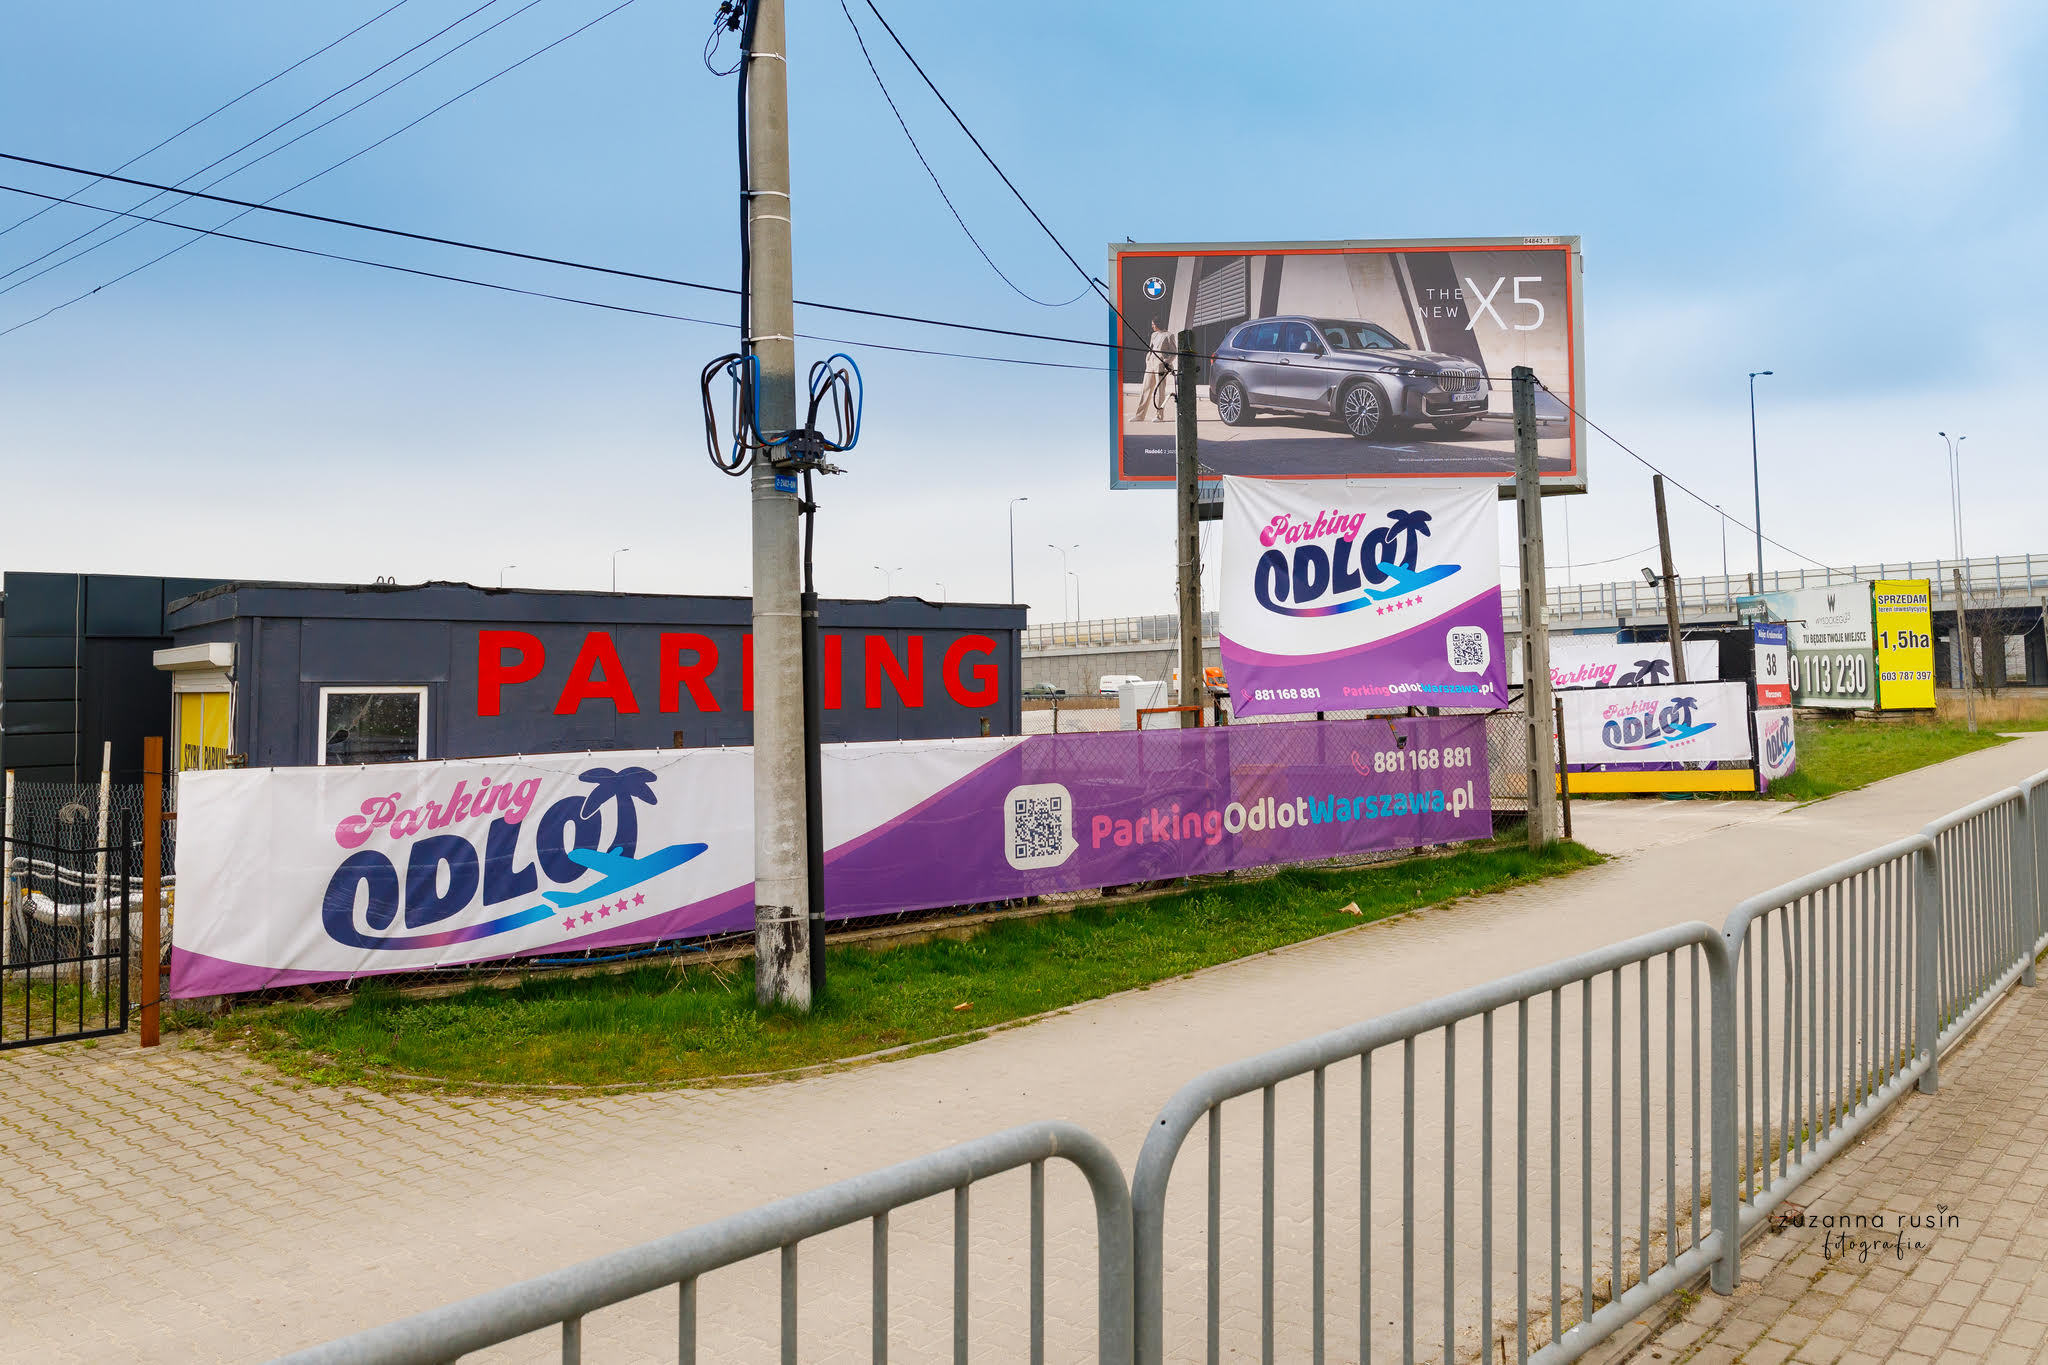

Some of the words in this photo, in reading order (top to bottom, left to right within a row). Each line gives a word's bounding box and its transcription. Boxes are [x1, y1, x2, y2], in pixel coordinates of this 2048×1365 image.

[1425, 288, 1463, 300] THE
[1464, 276, 1545, 331] X5
[1418, 306, 1459, 318] NEW
[1259, 509, 1366, 547] Parking
[1254, 509, 1433, 618] ODLOT
[1878, 594, 1927, 604] SPRZEDAM
[1803, 634, 1809, 644] TU
[1810, 633, 1827, 646] BĘDZIE
[1827, 632, 1844, 643] TWOJE
[1845, 631, 1867, 642] MIEJSCE
[1880, 631, 1930, 651] 1,5ha
[477, 630, 999, 716] PARING
[1766, 653, 1777, 676] 38
[1803, 655, 1831, 693] 113
[1836, 653, 1868, 694] 230
[1881, 672, 1897, 681] 603
[1899, 671, 1914, 680] 787
[1916, 671, 1931, 680] 397
[1254, 688, 1275, 700] 881
[1277, 688, 1298, 700] 168
[1300, 687, 1321, 699] 881
[1343, 681, 1494, 698] ParkingOdlotWarszawa.pl
[1602, 700, 1660, 720] Parking
[1601, 697, 1699, 750] ODLOT
[1374, 750, 1405, 773] 881
[1409, 748, 1440, 770] 168
[1443, 746, 1472, 768] 881
[335, 776, 543, 849] Parking
[1091, 780, 1474, 849] ParkingOdlotWarszawa.pl
[322, 766, 659, 950] ODLOT
